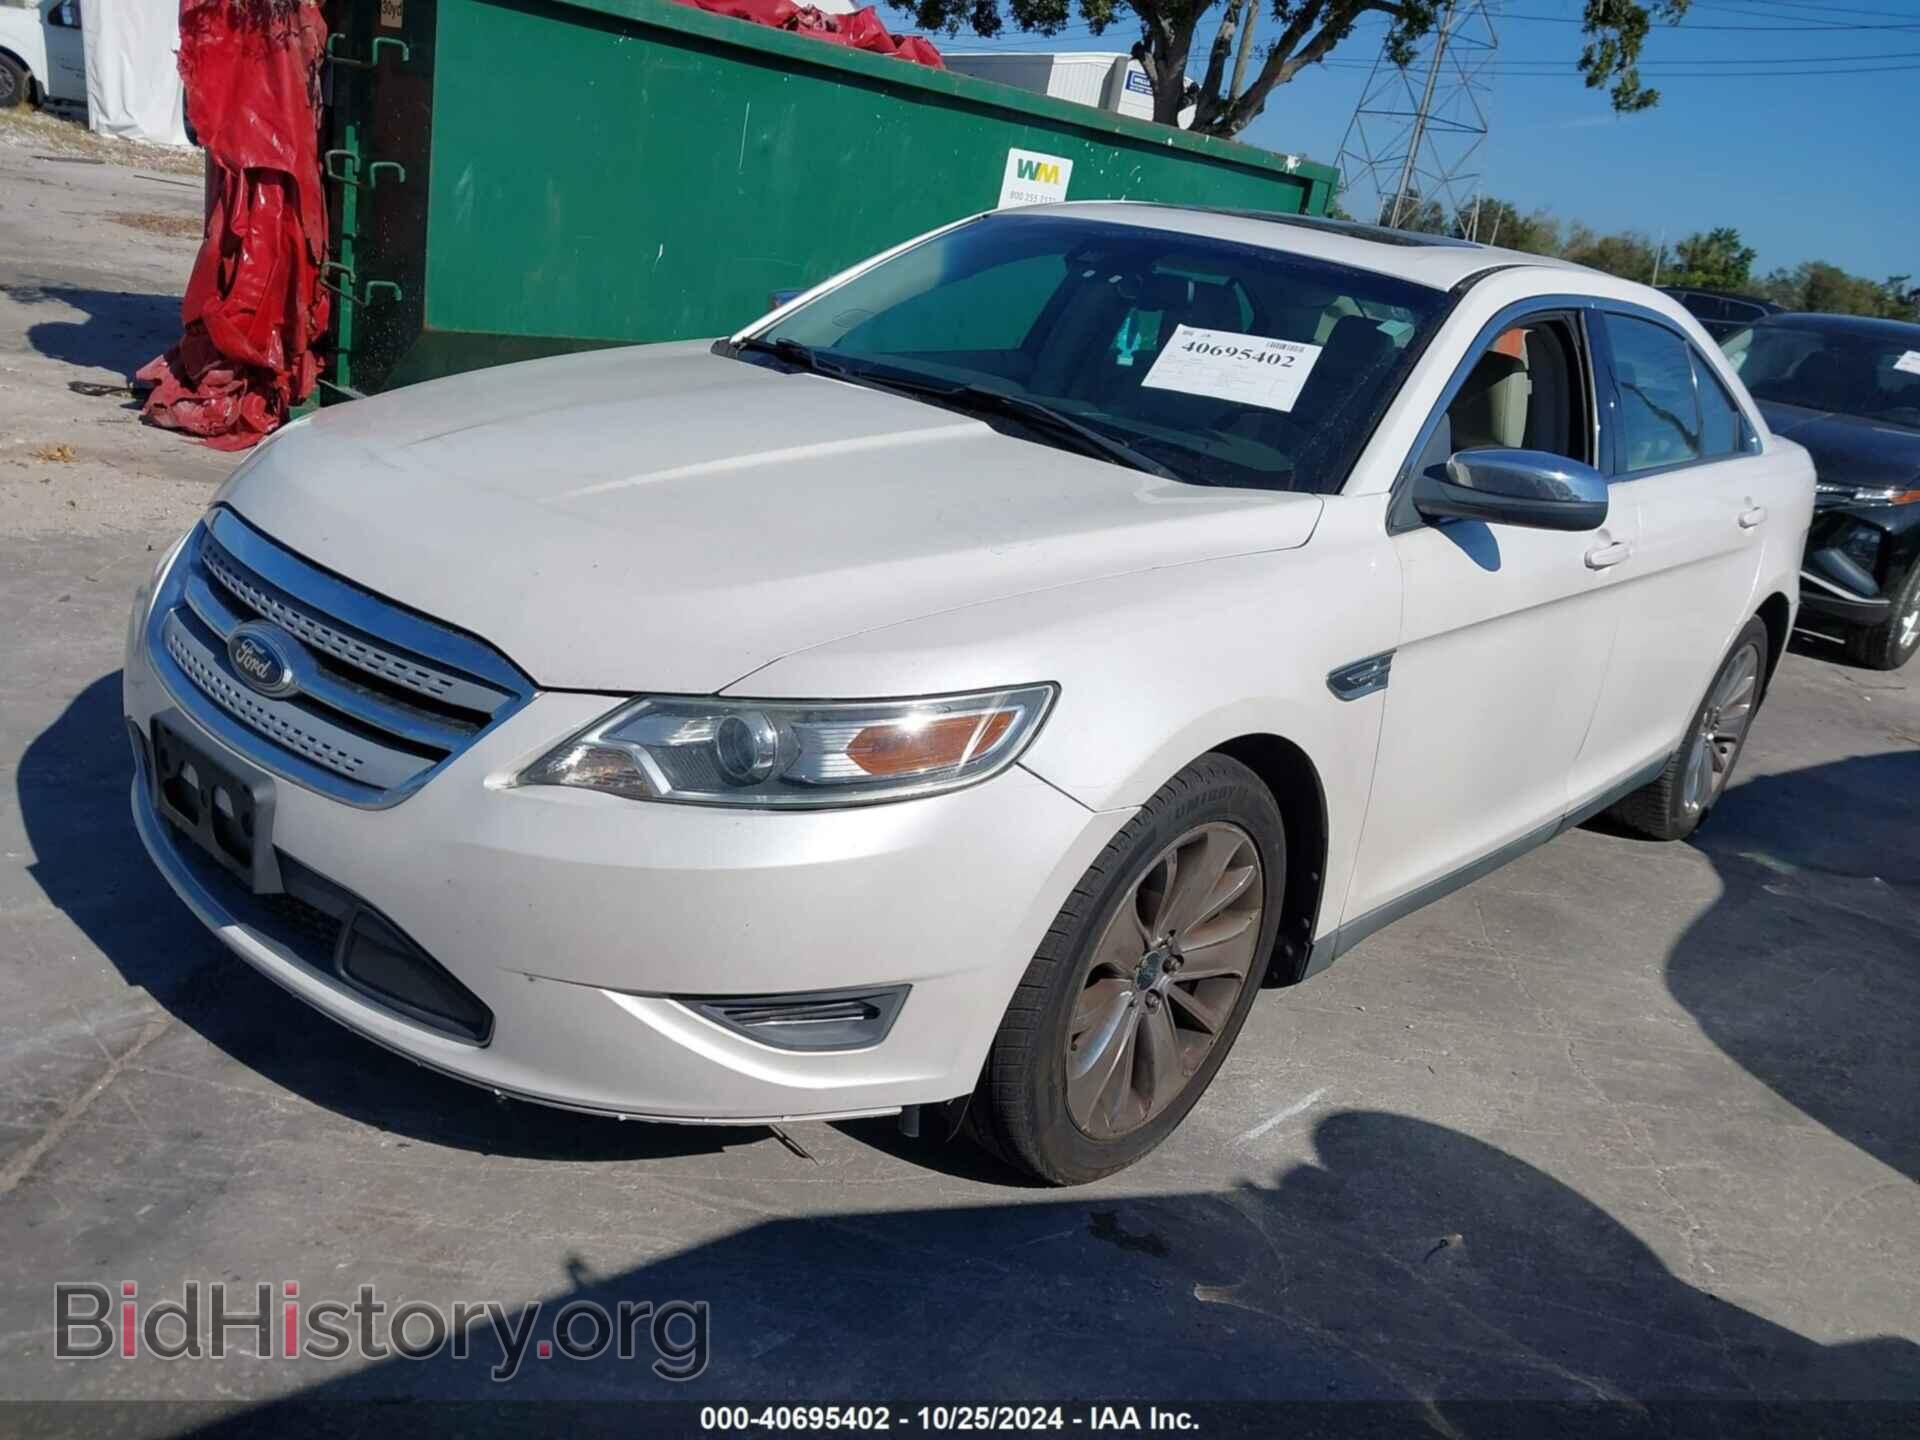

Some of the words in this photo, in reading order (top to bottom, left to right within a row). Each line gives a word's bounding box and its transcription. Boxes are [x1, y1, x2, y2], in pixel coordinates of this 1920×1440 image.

[1017, 158, 1060, 185] WM
[1181, 341, 1296, 368] 40695402
[235, 639, 272, 679] Ford
